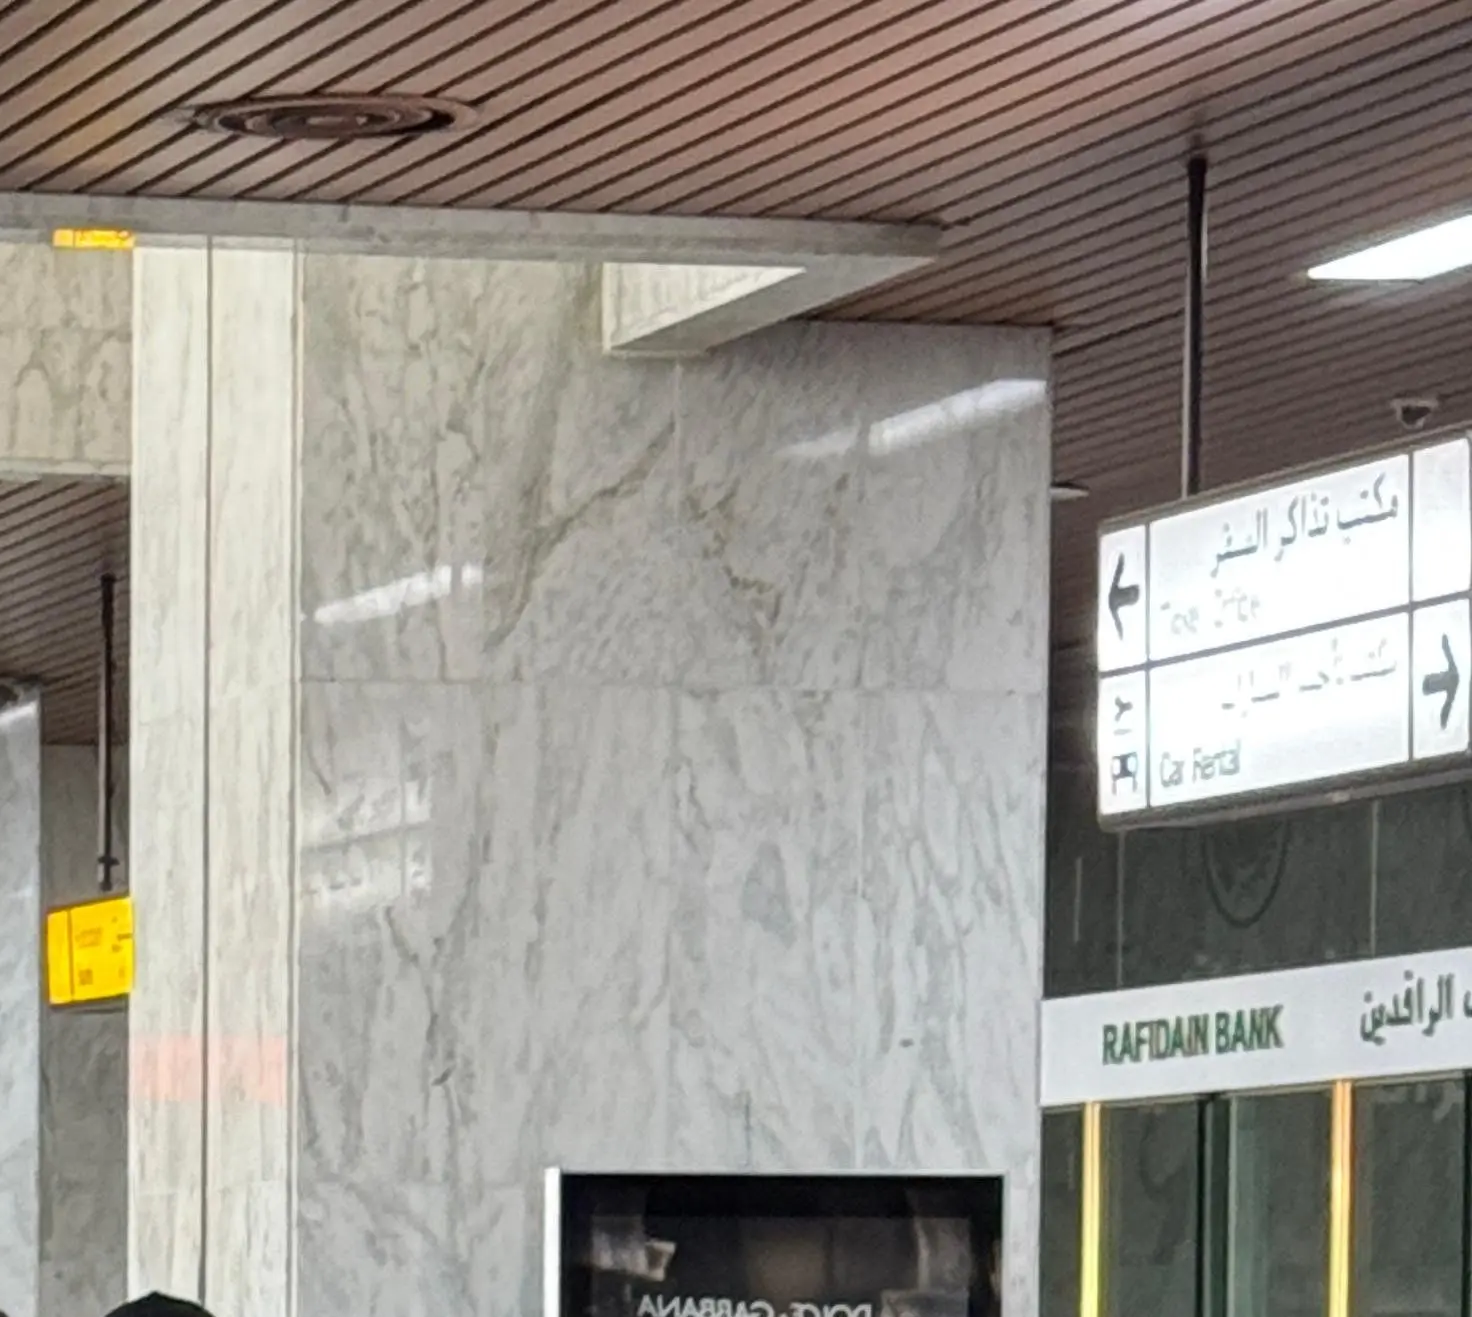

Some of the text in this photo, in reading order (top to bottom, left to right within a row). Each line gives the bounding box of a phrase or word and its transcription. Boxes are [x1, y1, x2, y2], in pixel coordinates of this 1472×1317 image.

[1102, 1003, 1285, 1066] RAFIDAIN BANK
[1359, 968, 1455, 1047] الرافدين
